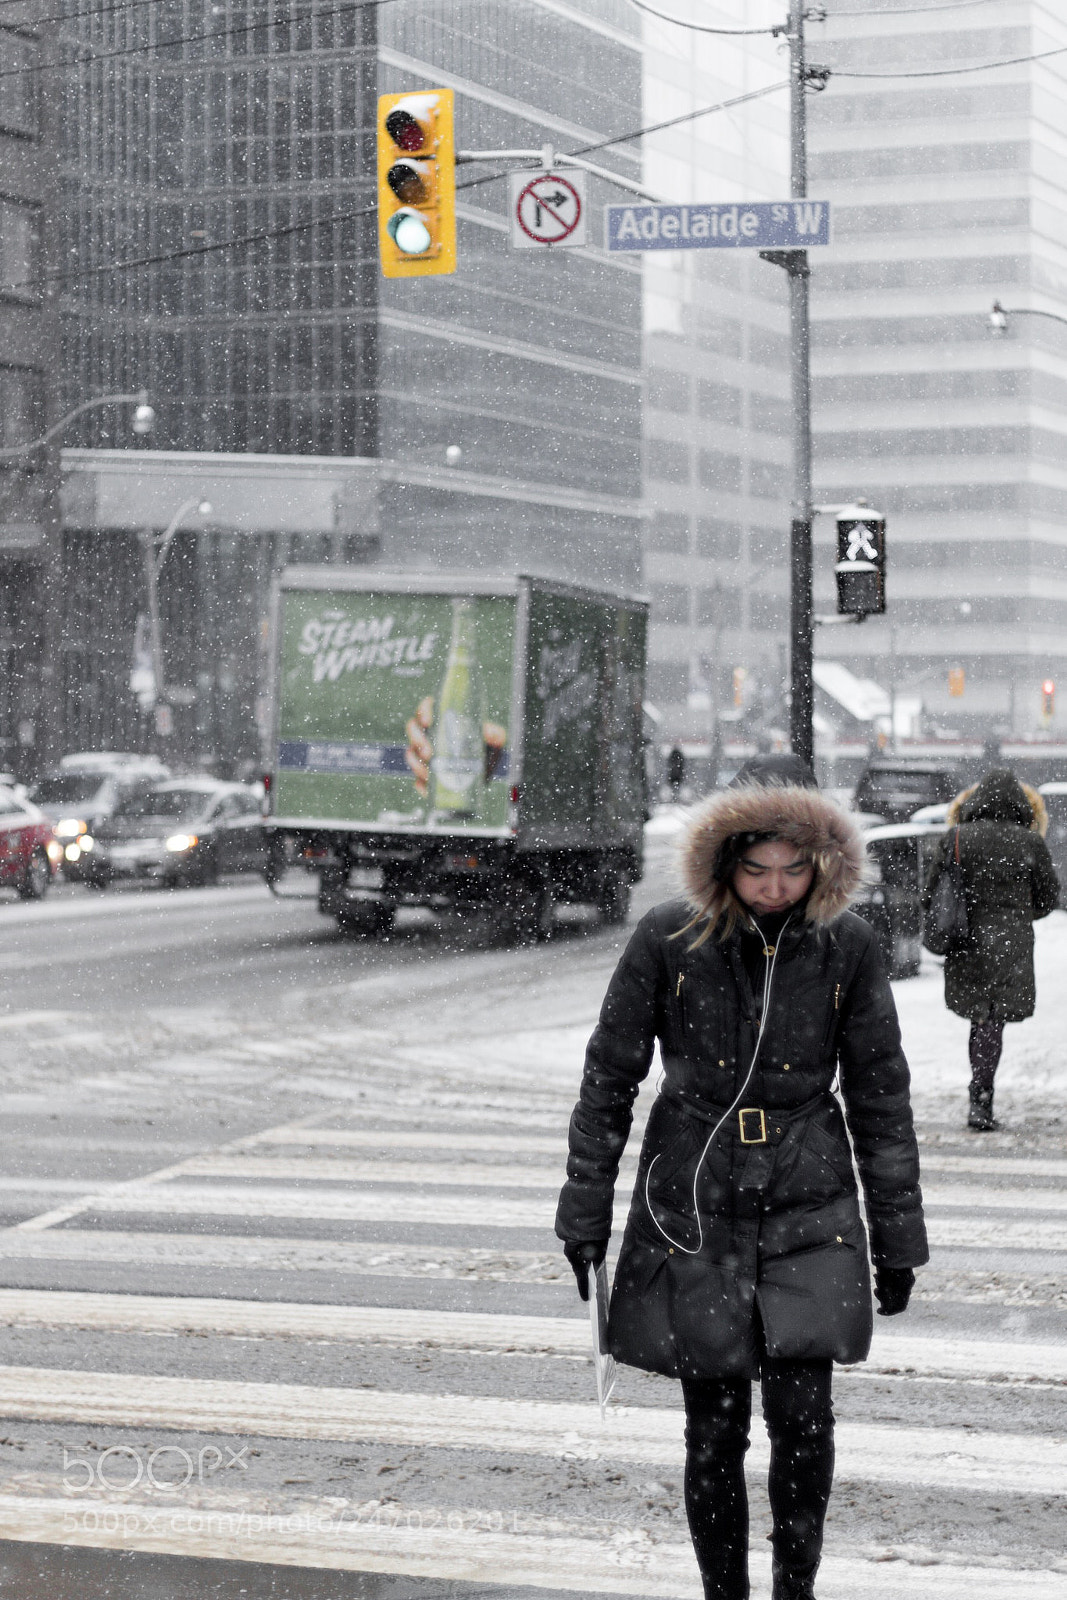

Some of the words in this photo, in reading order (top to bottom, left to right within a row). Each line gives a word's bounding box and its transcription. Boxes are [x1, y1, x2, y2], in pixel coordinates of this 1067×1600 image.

[617, 207, 760, 241] Adelaide
[771, 204, 789, 221] St
[795, 203, 822, 234] W
[299, 615, 395, 654] STEAM
[313, 633, 438, 683] WHISTLE
